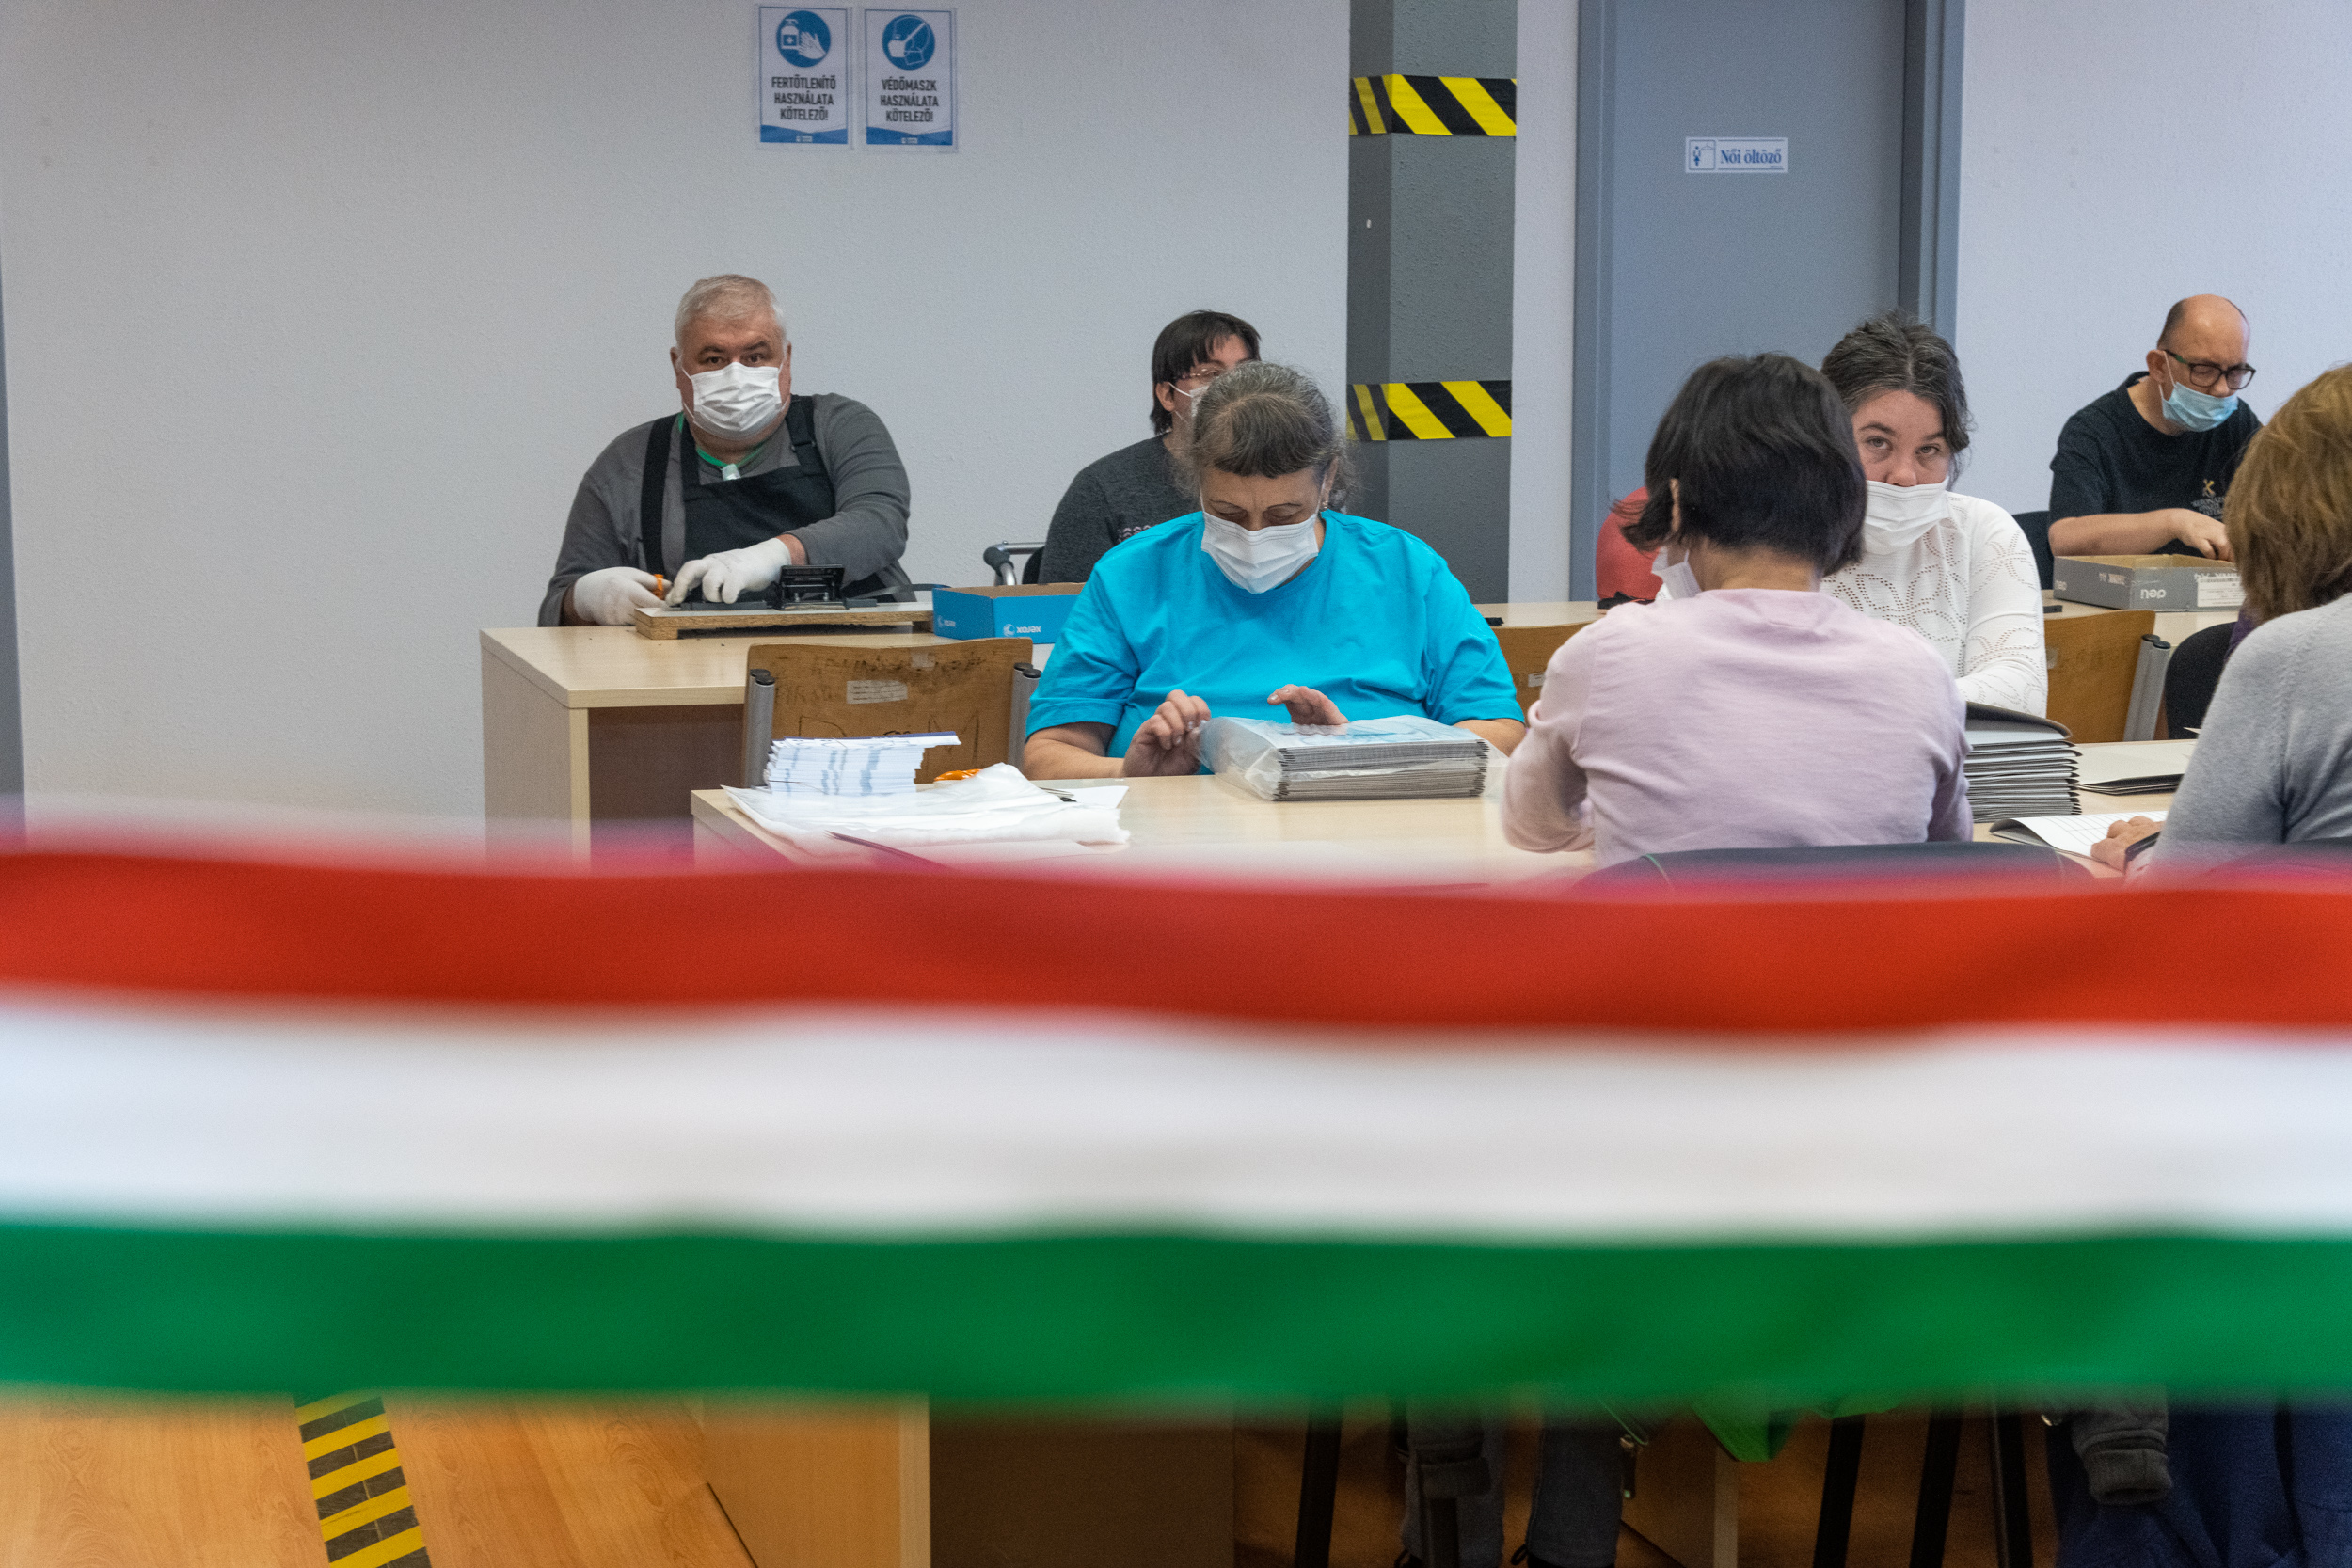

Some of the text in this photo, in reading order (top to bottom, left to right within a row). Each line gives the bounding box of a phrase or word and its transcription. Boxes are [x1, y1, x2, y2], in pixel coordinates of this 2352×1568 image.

[771, 74, 836, 89] FERTŐTLENÍTŐ
[882, 76, 937, 91] VÉDŐMASZK
[774, 91, 834, 105] HASZNÁLATA
[880, 92, 939, 107] HASZNÁLATA
[780, 106, 829, 120] KÖTELEZŐ!
[885, 108, 933, 122] KÖTELEZŐ!
[1720, 148, 1782, 164] Női öltöző
[2140, 589, 2167, 599] deli
[1016, 626, 1042, 634] xerox
